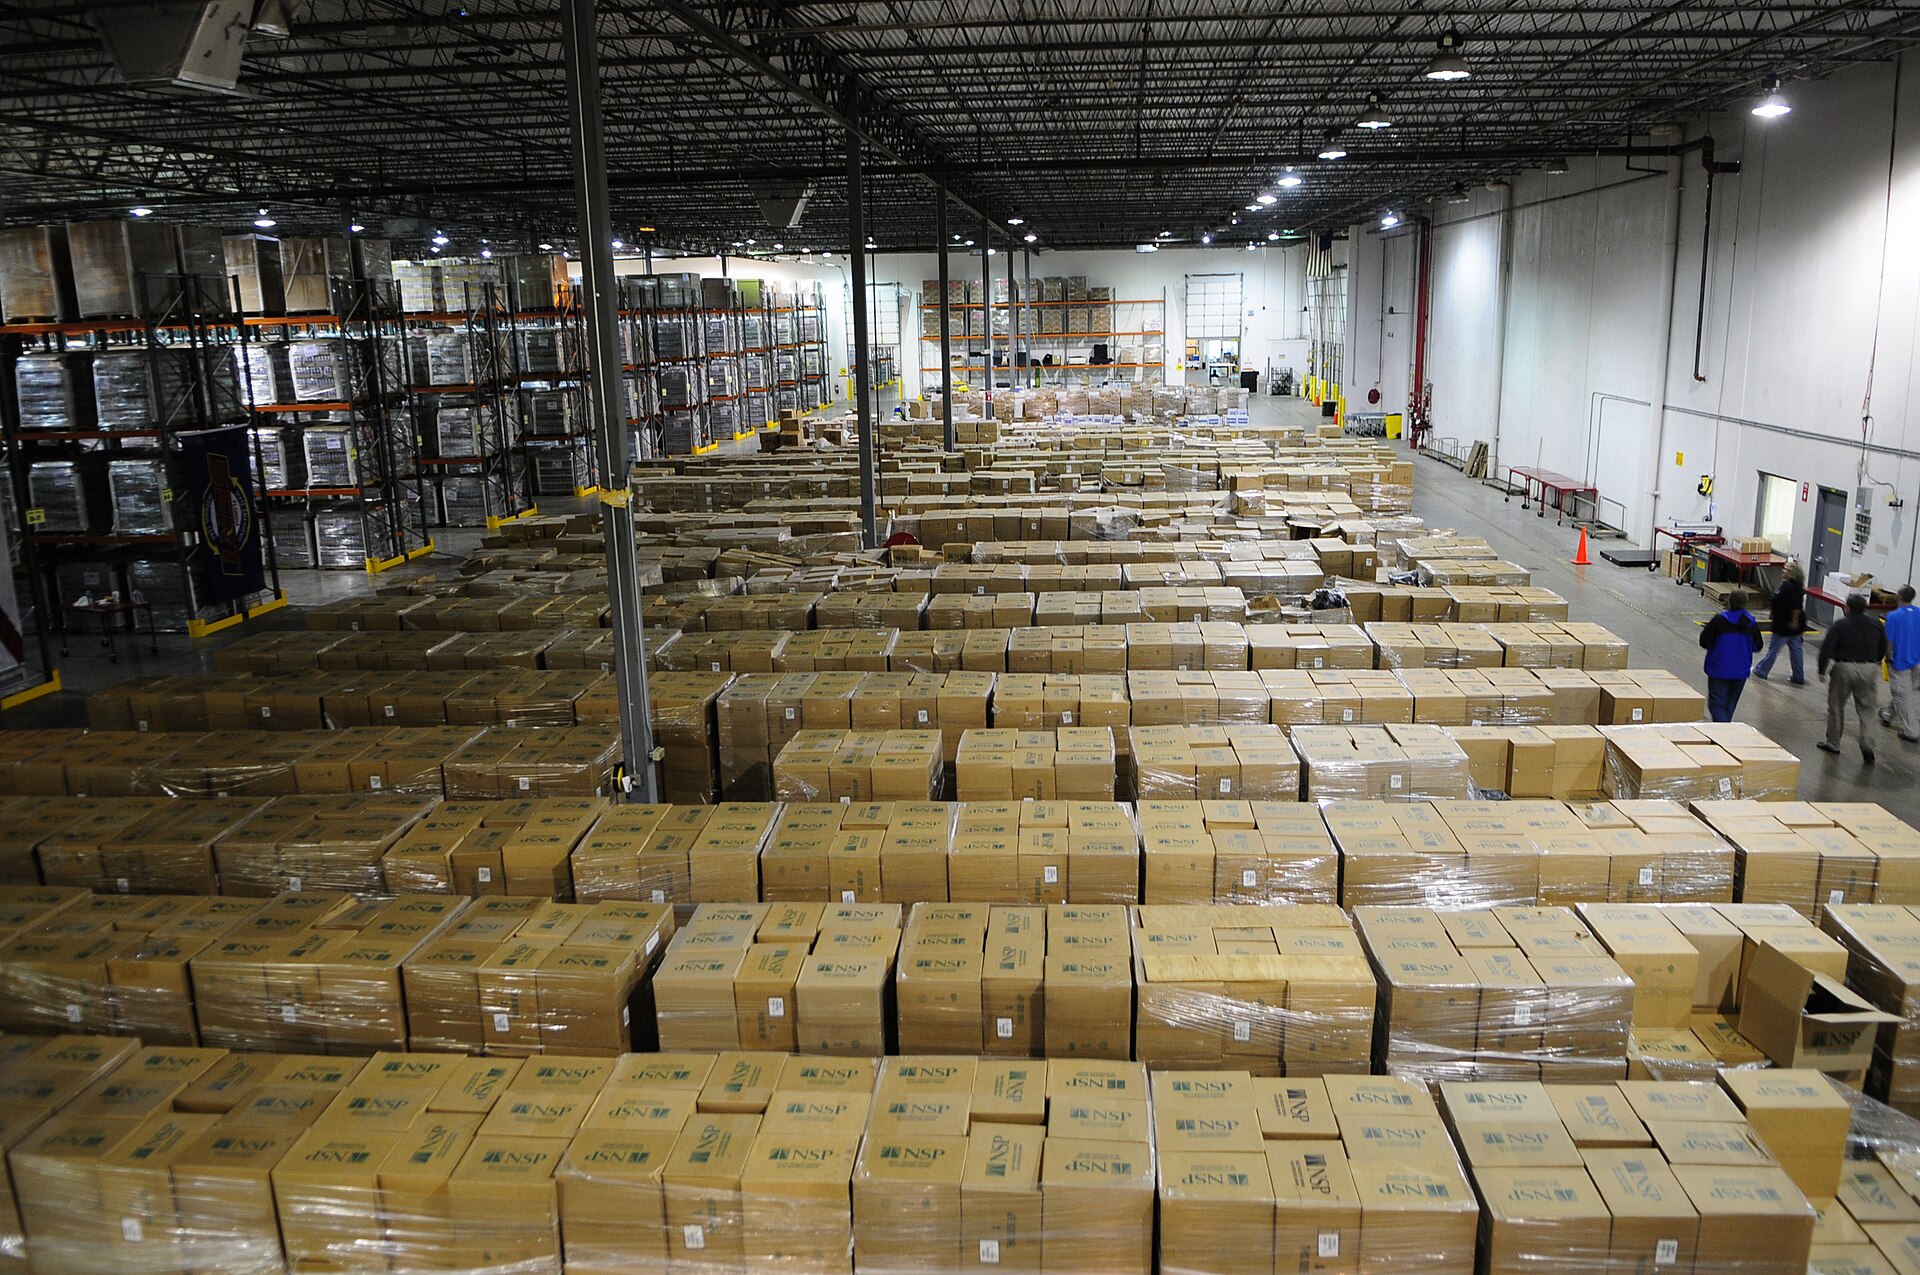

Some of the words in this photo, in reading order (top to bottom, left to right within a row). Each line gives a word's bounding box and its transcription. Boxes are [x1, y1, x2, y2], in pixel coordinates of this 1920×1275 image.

[707, 913, 735, 921] NSP
[854, 910, 884, 918] NSP
[926, 912, 955, 920] NSP
[1080, 911, 1110, 919] NSP
[1376, 916, 1405, 924] NSP
[397, 924, 426, 932] NSP
[687, 935, 717, 943] NSP
[852, 935, 882, 943] NSP
[917, 937, 948, 945] NSP
[1082, 936, 1113, 944] NSP
[1166, 934, 1198, 942] NSP
[1294, 939, 1326, 947] NSP
[1387, 941, 1421, 949] NSP
[343, 951, 375, 960] NSP
[427, 953, 459, 961] NSP
[559, 957, 592, 966] NSP
[674, 963, 707, 971] NSP
[934, 959, 966, 968] NSP
[834, 964, 868, 973] NSP
[1080, 964, 1113, 973] NSP
[1420, 964, 1453, 972] NSP
[1571, 965, 1604, 974] NSP
[1828, 1031, 1862, 1047] NSP
[401, 1062, 440, 1072] NSP
[730, 1061, 751, 1082] NSP
[920, 1067, 957, 1077] NSP
[285, 1071, 322, 1082] NSP
[556, 1068, 595, 1079] NSP
[632, 1071, 670, 1081] NSP
[821, 1069, 858, 1079] NSP
[1066, 1077, 1103, 1088] NSP
[1195, 1081, 1232, 1092] NSP
[1006, 1080, 1024, 1102] NSP
[1757, 1086, 1794, 1097] NSP
[1350, 1093, 1389, 1104] NSP
[1488, 1093, 1528, 1104] NSP
[1668, 1092, 1709, 1103] NSP
[274, 1098, 314, 1110] NSP
[368, 1098, 408, 1109] NSP
[808, 1103, 848, 1114] NSP
[911, 1103, 950, 1114] NSP
[530, 1104, 572, 1116] NSP
[609, 1107, 650, 1117] NSP
[1093, 1110, 1132, 1121] NSP
[1289, 1099, 1310, 1123] NSP
[1199, 1119, 1239, 1130] NSP
[696, 1125, 720, 1150] NSP
[1385, 1127, 1427, 1140] NSP
[1506, 1132, 1549, 1144] NSP
[233, 1140, 275, 1151] NSP
[990, 1135, 1010, 1162] NSP
[1682, 1139, 1723, 1151] NSP
[305, 1151, 347, 1162] NSP
[504, 1152, 547, 1164] NSP
[584, 1151, 628, 1162] NSP
[792, 1149, 833, 1161] NSP
[904, 1148, 945, 1160] NSP
[1065, 1161, 1106, 1173] NSP
[1182, 1173, 1224, 1185] NSP
[1306, 1166, 1331, 1195] NSP
[1379, 1183, 1422, 1196] NSP
[1508, 1189, 1551, 1201] NSP
[1710, 1188, 1754, 1200] NSP
